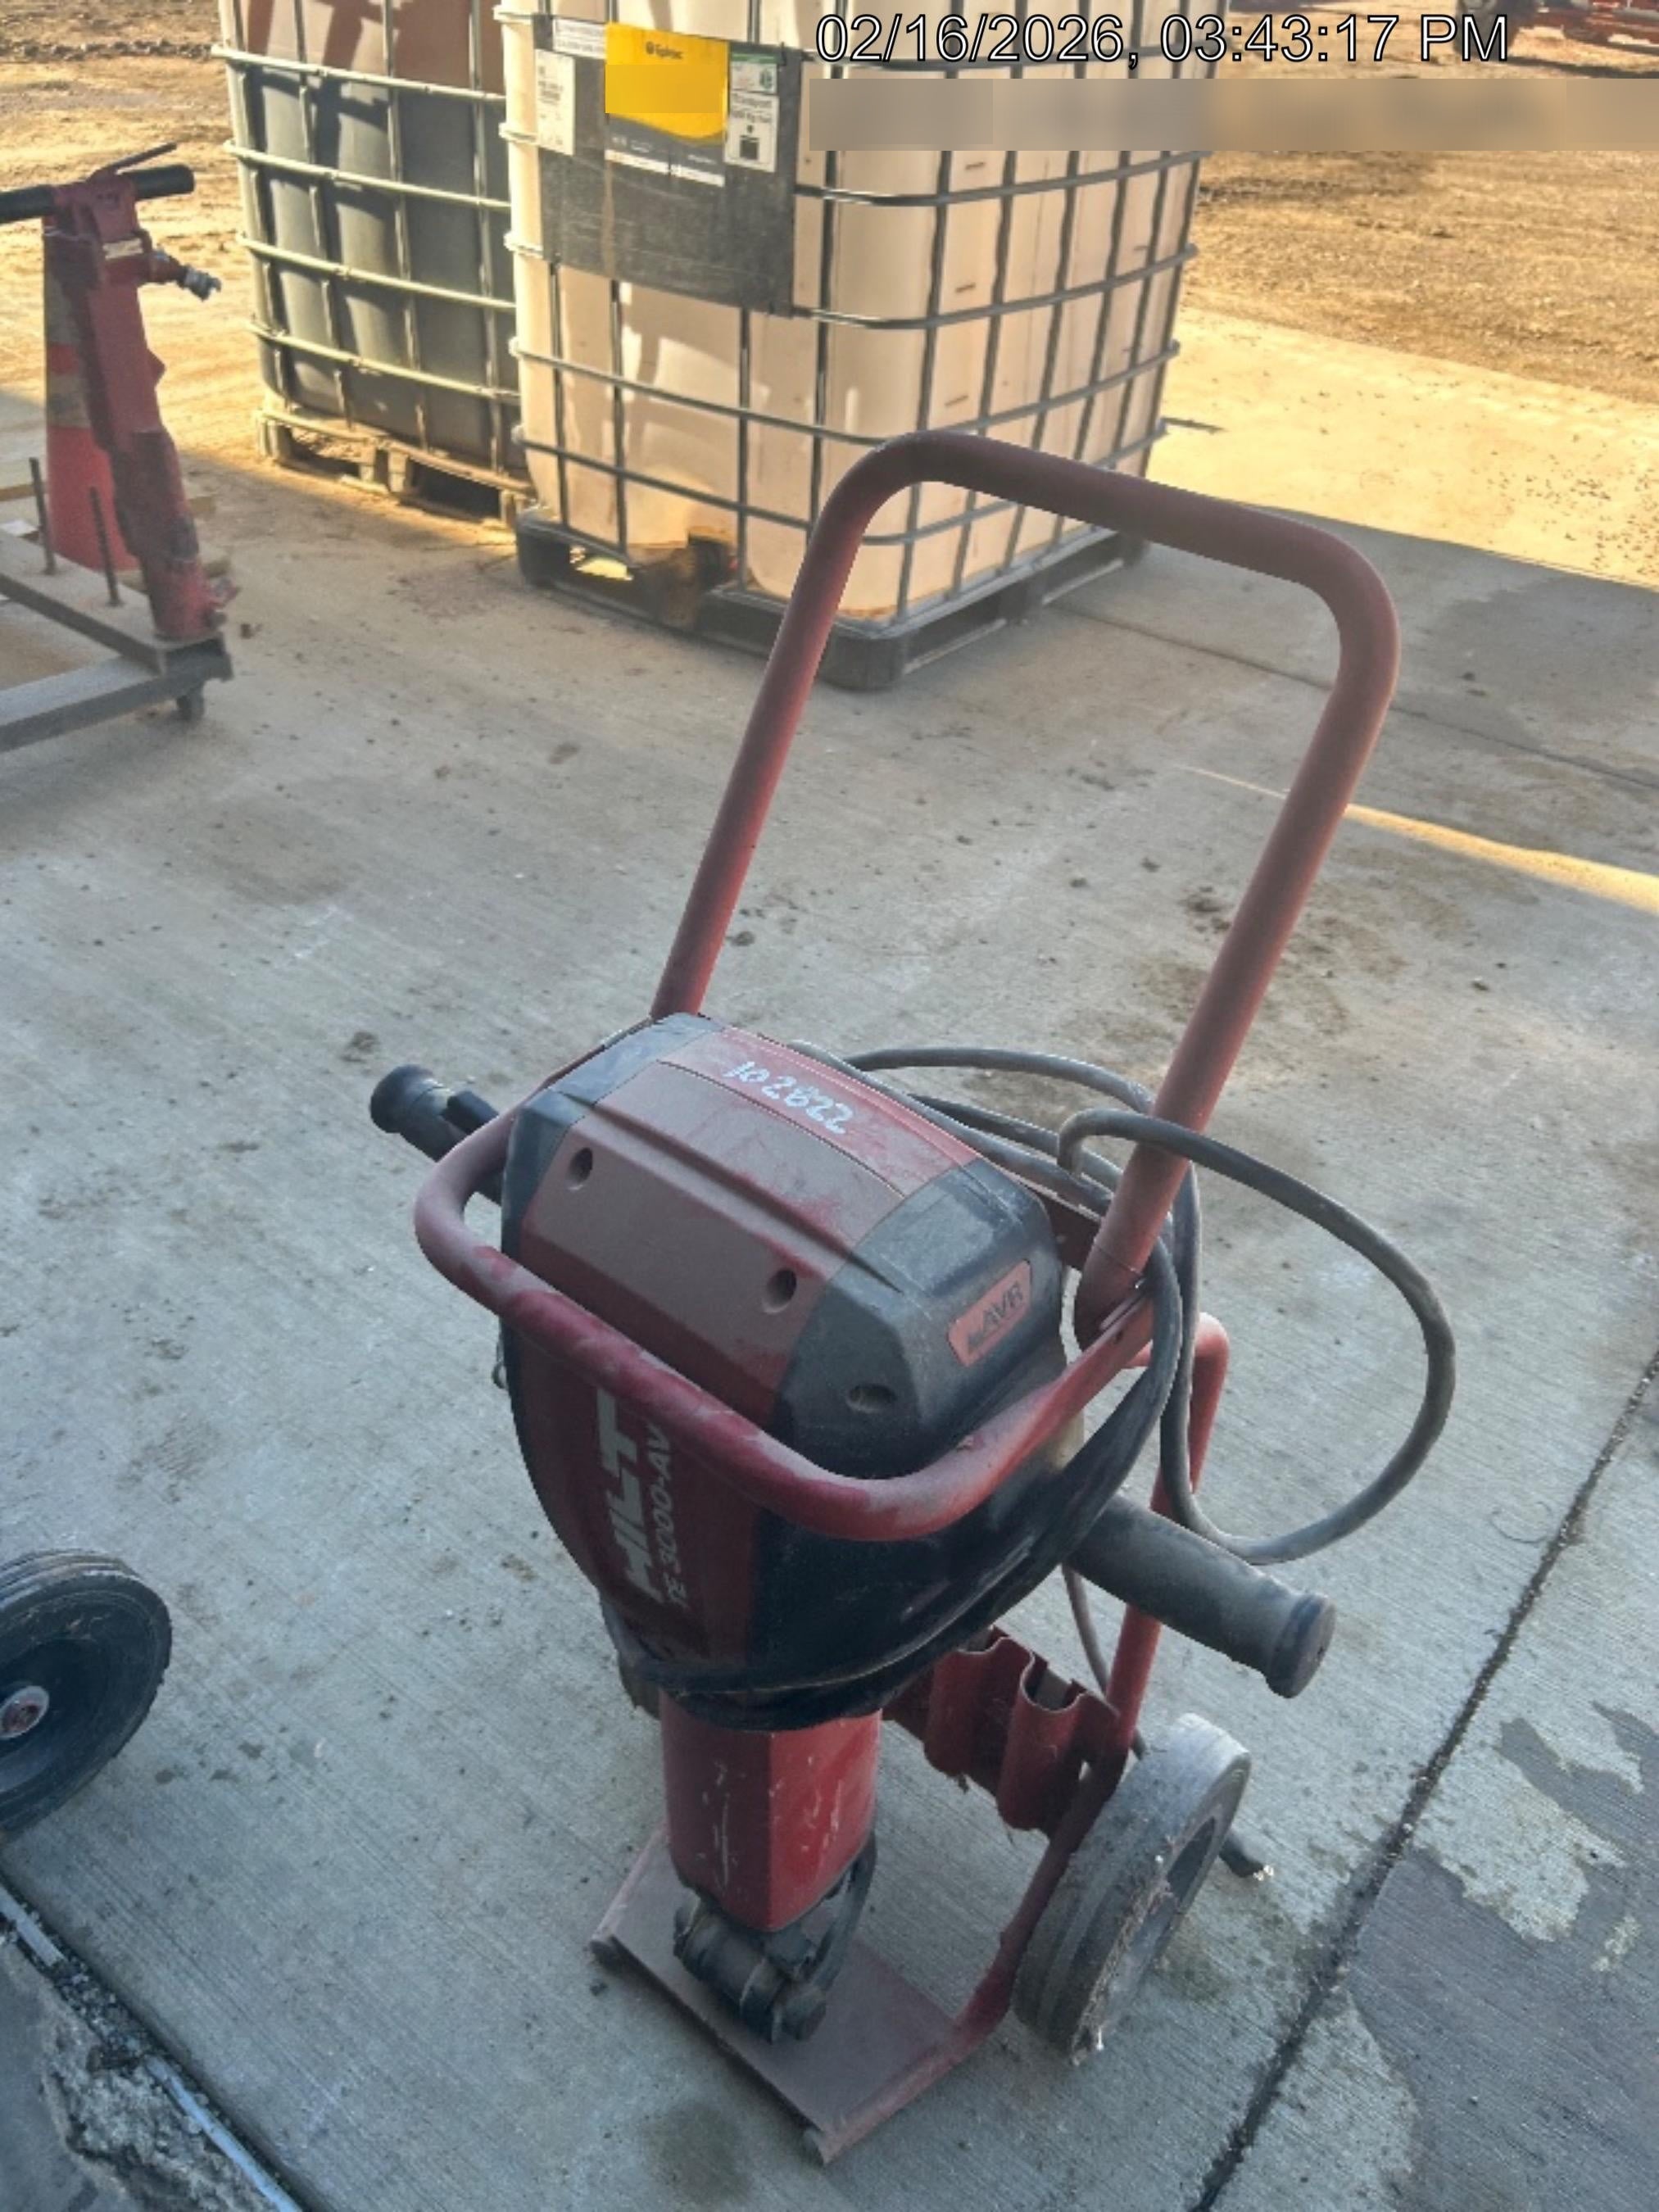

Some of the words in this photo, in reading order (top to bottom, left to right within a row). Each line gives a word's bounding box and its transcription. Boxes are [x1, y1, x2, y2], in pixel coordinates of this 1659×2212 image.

[984, 1280, 1024, 1334] AVR
[596, 1388, 664, 1604] HILT
[646, 1421, 682, 1575] 3000-AV
